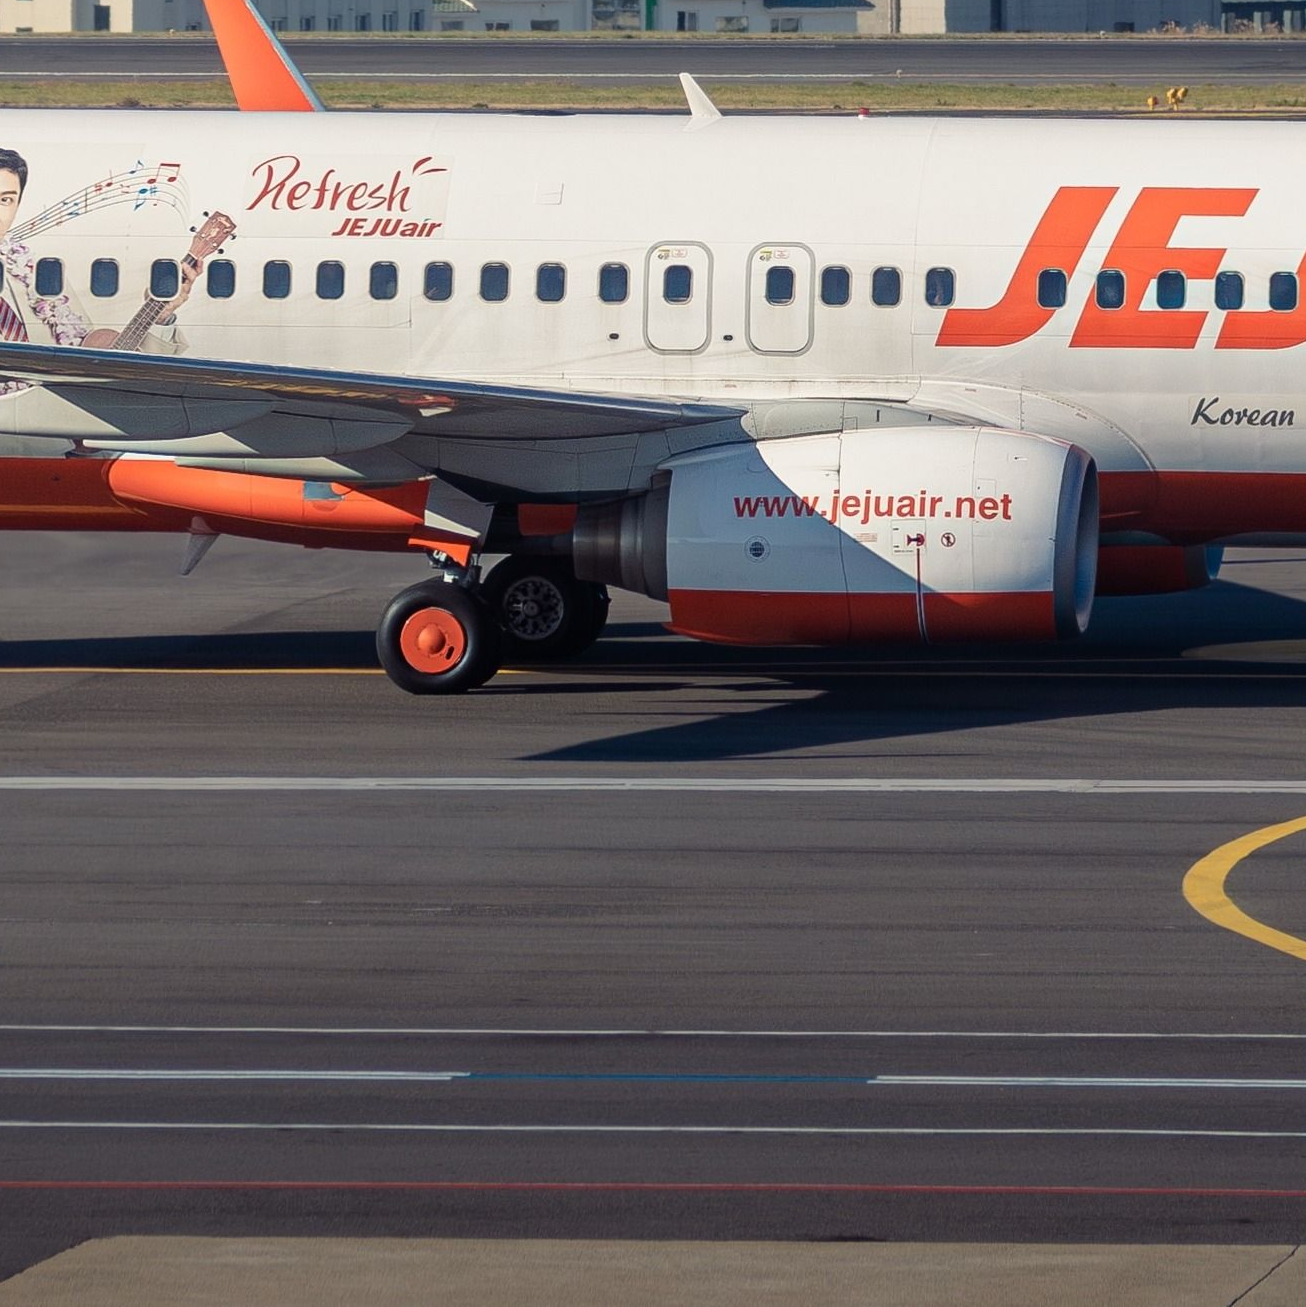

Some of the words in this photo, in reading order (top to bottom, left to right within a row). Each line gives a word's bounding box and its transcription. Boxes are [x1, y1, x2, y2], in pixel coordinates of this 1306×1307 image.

[245, 155, 413, 212] Refresh
[331, 217, 442, 237] JEJUair
[1191, 397, 1294, 425] Korean
[733, 490, 1012, 525] www.jejuair.net
